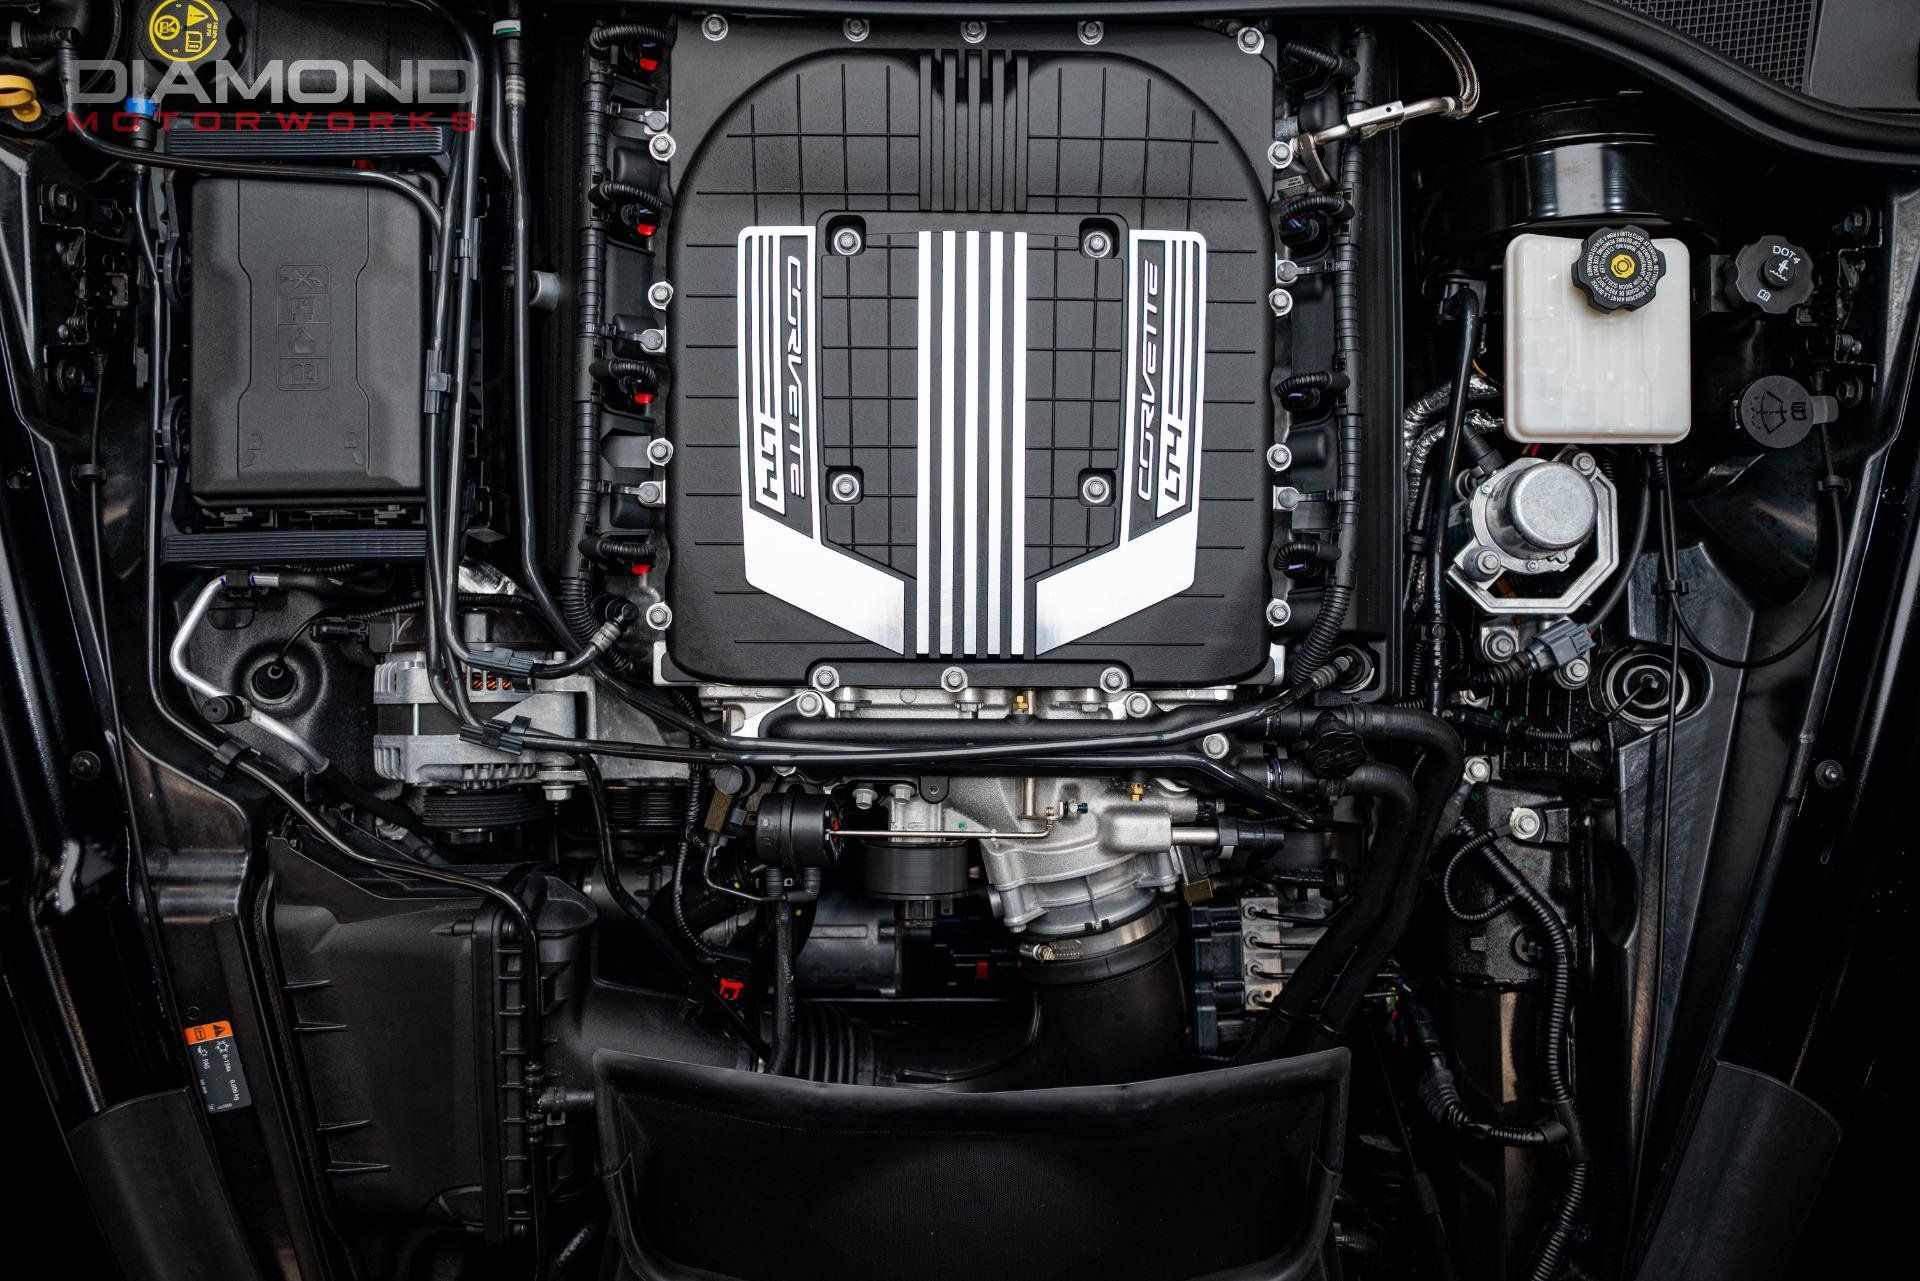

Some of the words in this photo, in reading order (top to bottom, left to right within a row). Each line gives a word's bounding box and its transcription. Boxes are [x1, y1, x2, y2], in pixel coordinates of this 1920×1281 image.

[1606, 231, 1619, 240] FROM
[1632, 232, 1645, 242] DOT3
[1591, 238, 1605, 253] SEALED
[1631, 238, 1641, 247] CAP
[1602, 246, 1614, 259] CLEAN
[1587, 251, 1595, 277] CONTAINER
[1593, 254, 1601, 264] USE
[1636, 250, 1646, 276] PROVENANT
[1644, 271, 1652, 282] QUE
[1648, 264, 1658, 287] NETTOYER
[1640, 280, 1648, 288] DU
[1643, 285, 1651, 293] LE
[1602, 291, 1611, 299] LA
[1603, 285, 1618, 296] FREIN
[1625, 285, 1643, 296] LIQUIDE
[1625, 289, 1646, 302] BOUCHON
[1609, 294, 1624, 302] AVANT
[787, 256, 806, 498] CORVETTE
[1137, 260, 1160, 501] CORVETTE
[760, 421, 779, 501] LT4
[1165, 421, 1184, 501] LT4
[201, 1058, 211, 1070] PAG
[222, 1053, 232, 1073] R-134a
